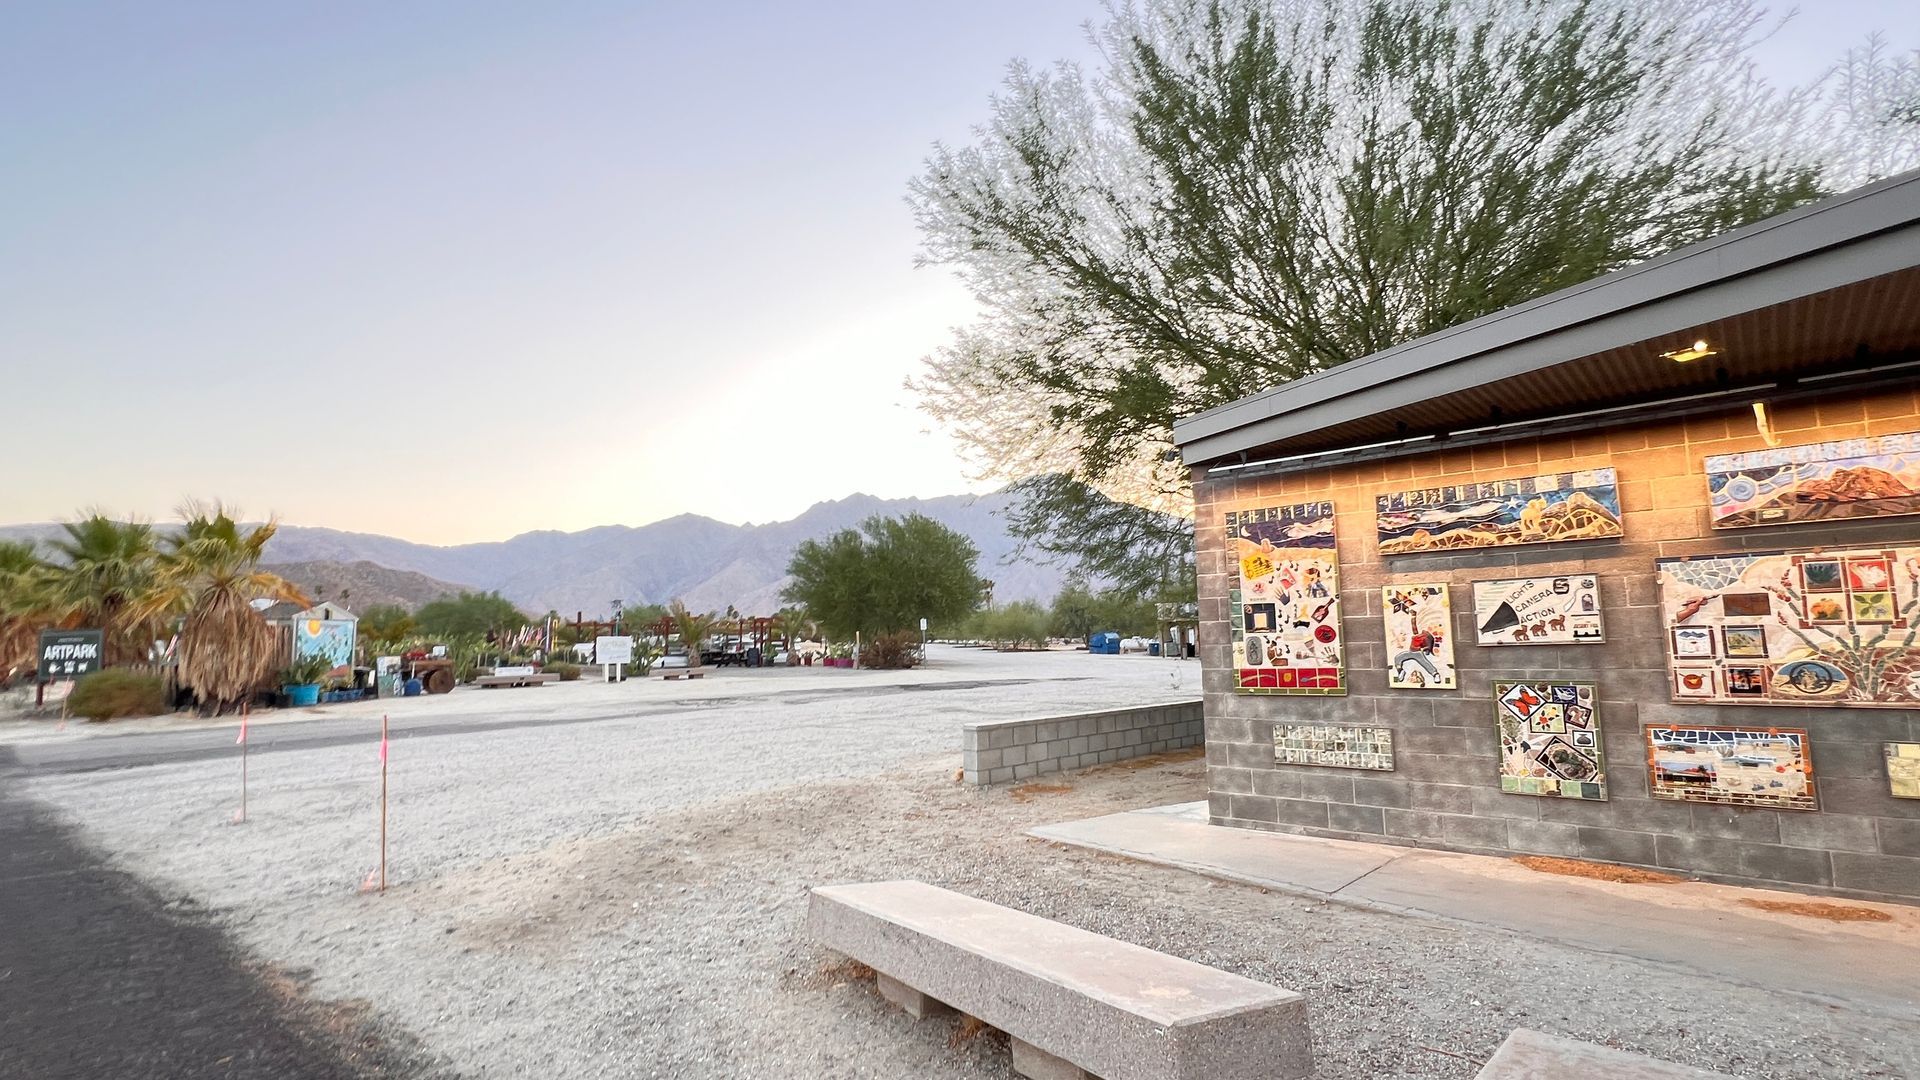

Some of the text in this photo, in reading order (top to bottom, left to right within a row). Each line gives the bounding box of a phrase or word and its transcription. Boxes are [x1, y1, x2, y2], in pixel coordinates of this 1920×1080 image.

[1506, 580, 1535, 604] LIGHTS
[1515, 589, 1553, 612] CAMERA
[1520, 607, 1556, 624] ACTION
[43, 643, 97, 660] ARTPARK
